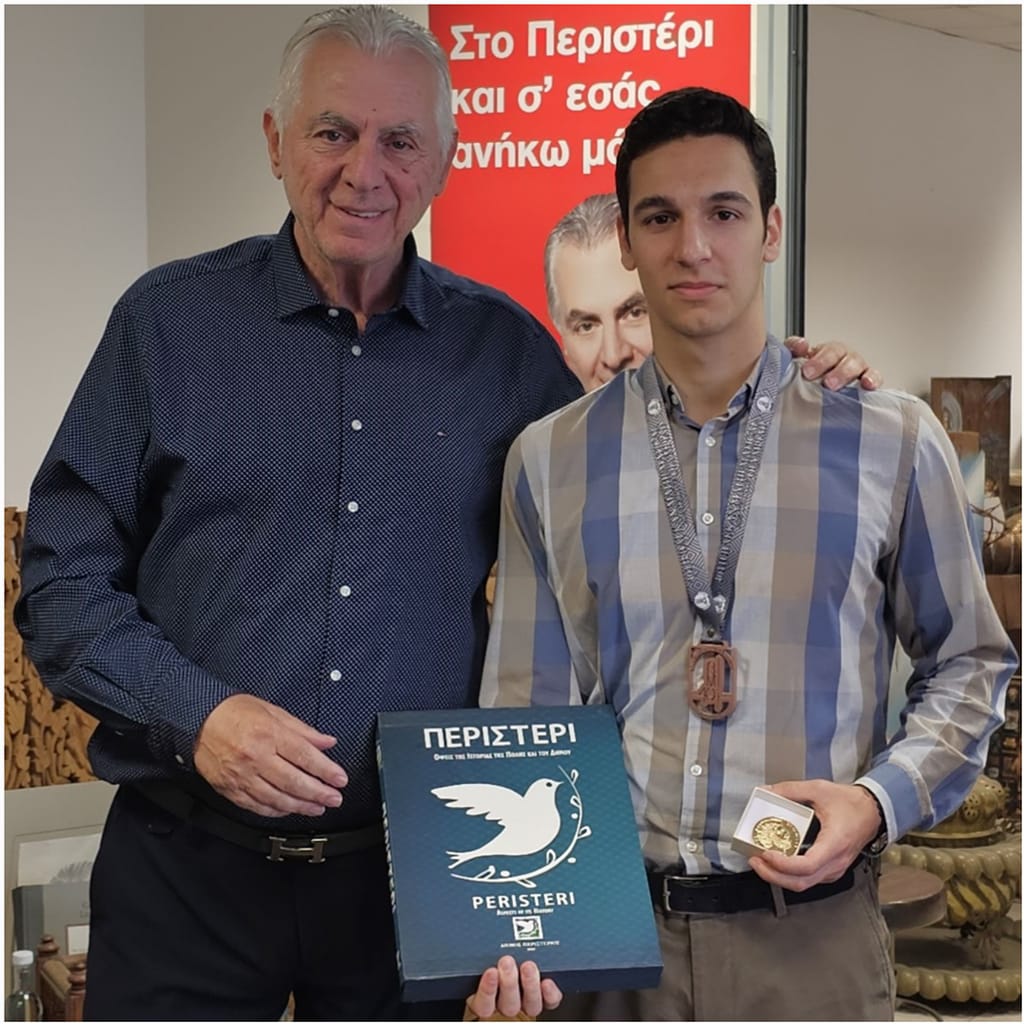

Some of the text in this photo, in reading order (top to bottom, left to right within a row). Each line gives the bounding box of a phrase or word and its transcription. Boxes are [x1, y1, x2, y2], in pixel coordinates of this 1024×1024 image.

[450, 12, 714, 63] Στο Περιστέρι
[451, 86, 505, 115] και
[566, 71, 661, 112] εσάς
[452, 132, 570, 170] ανήκω
[423, 722, 577, 749] ΠΕΡΙΣΤΕΡΙ
[472, 891, 576, 910] PERISTERI
